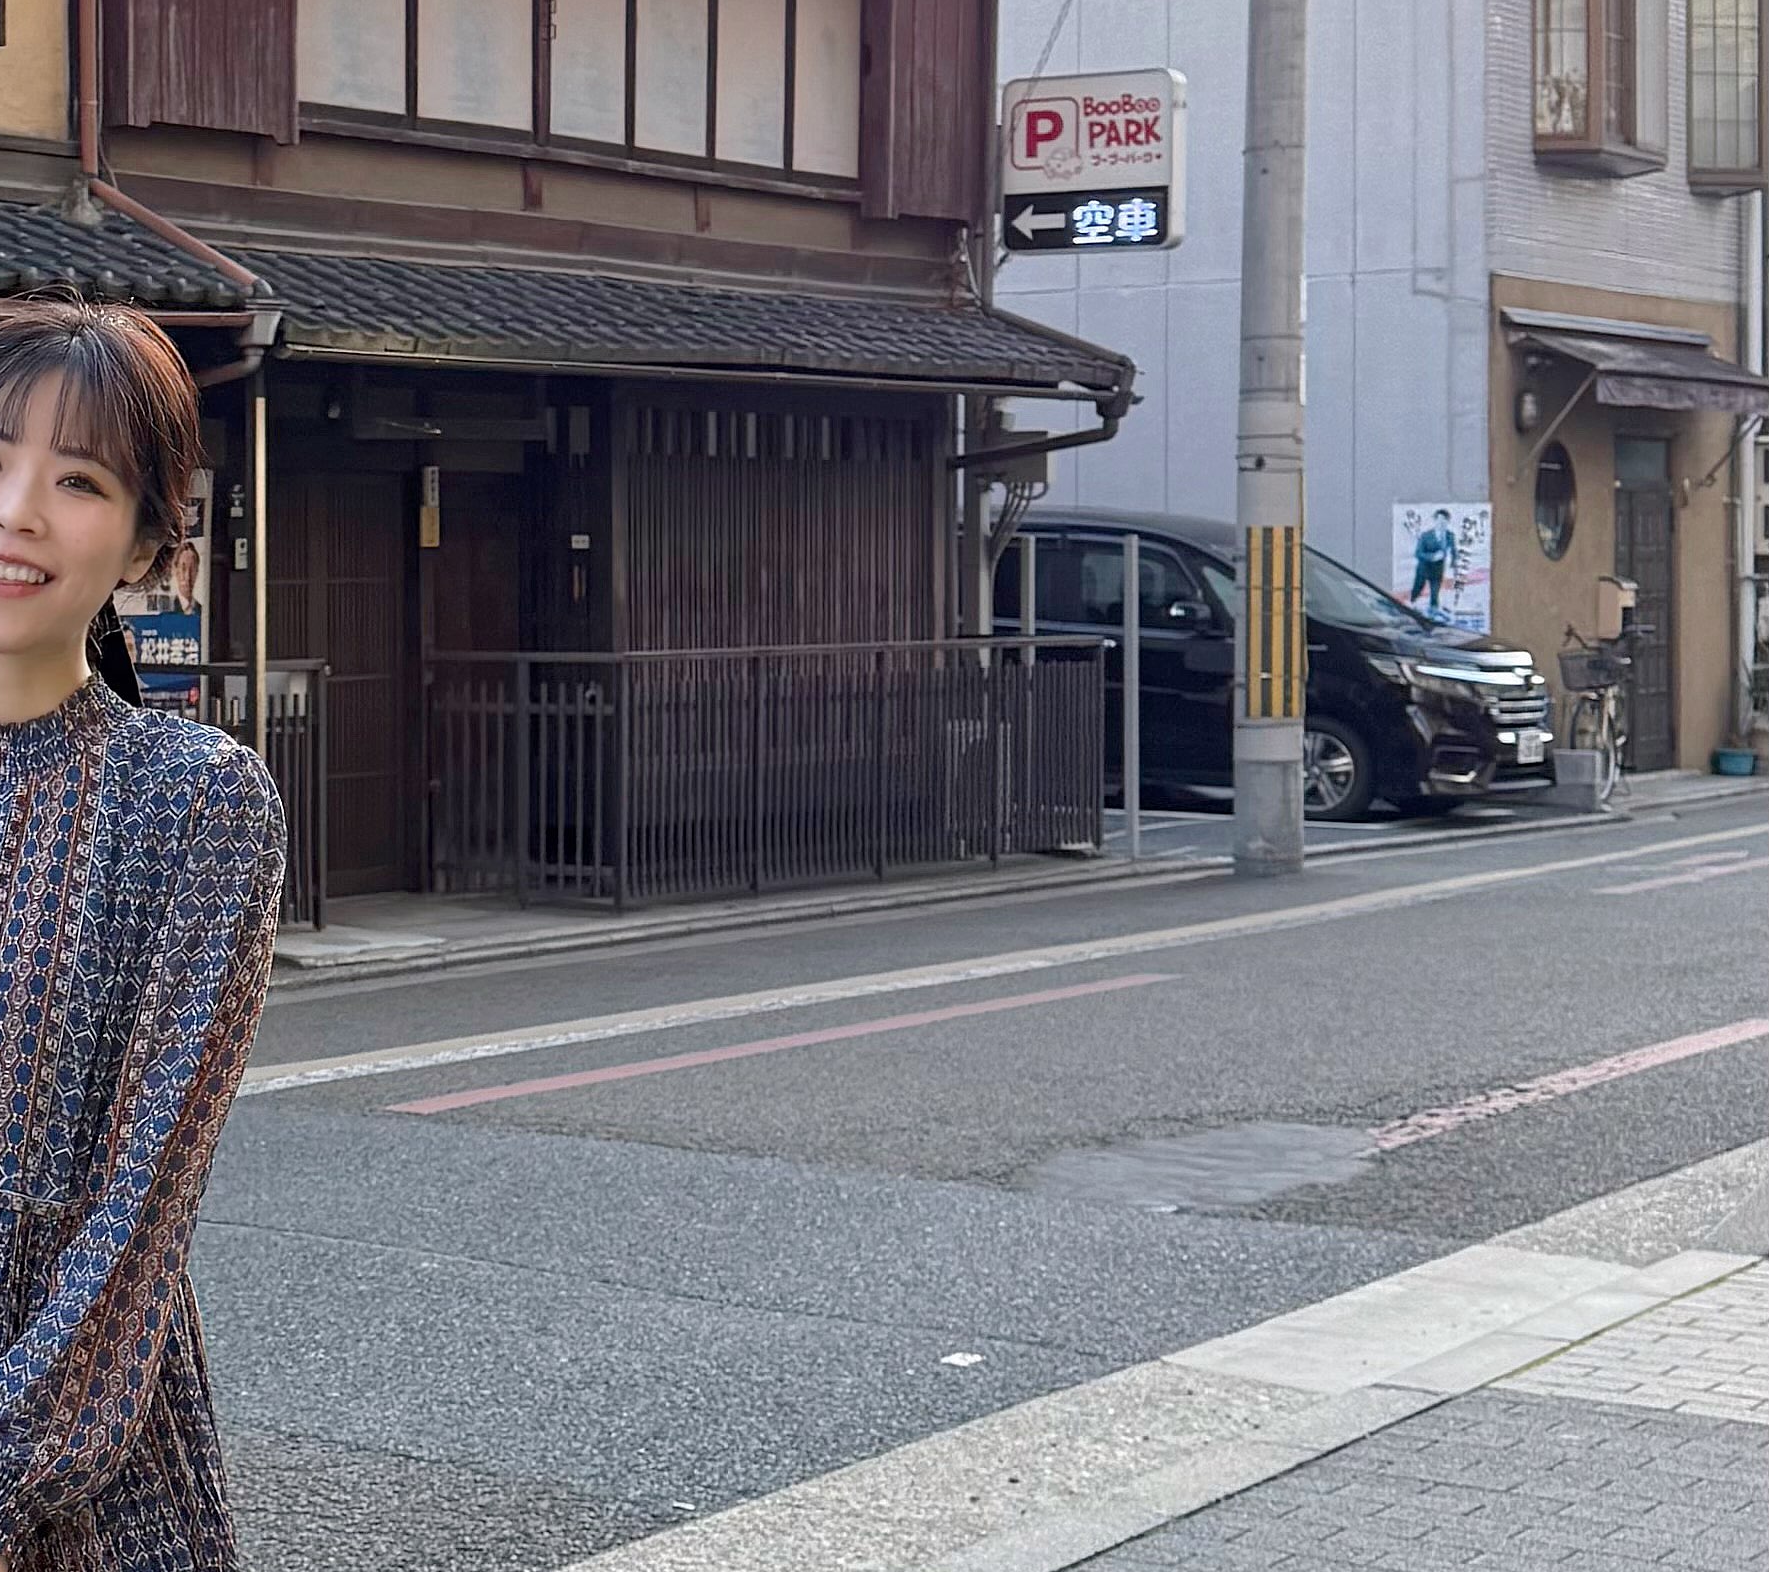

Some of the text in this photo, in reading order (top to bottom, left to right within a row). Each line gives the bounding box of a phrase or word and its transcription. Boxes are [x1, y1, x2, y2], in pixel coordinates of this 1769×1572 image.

[1025, 110, 1064, 159] P
[1088, 115, 1162, 149] PARK
[1072, 197, 1158, 245] 空車
